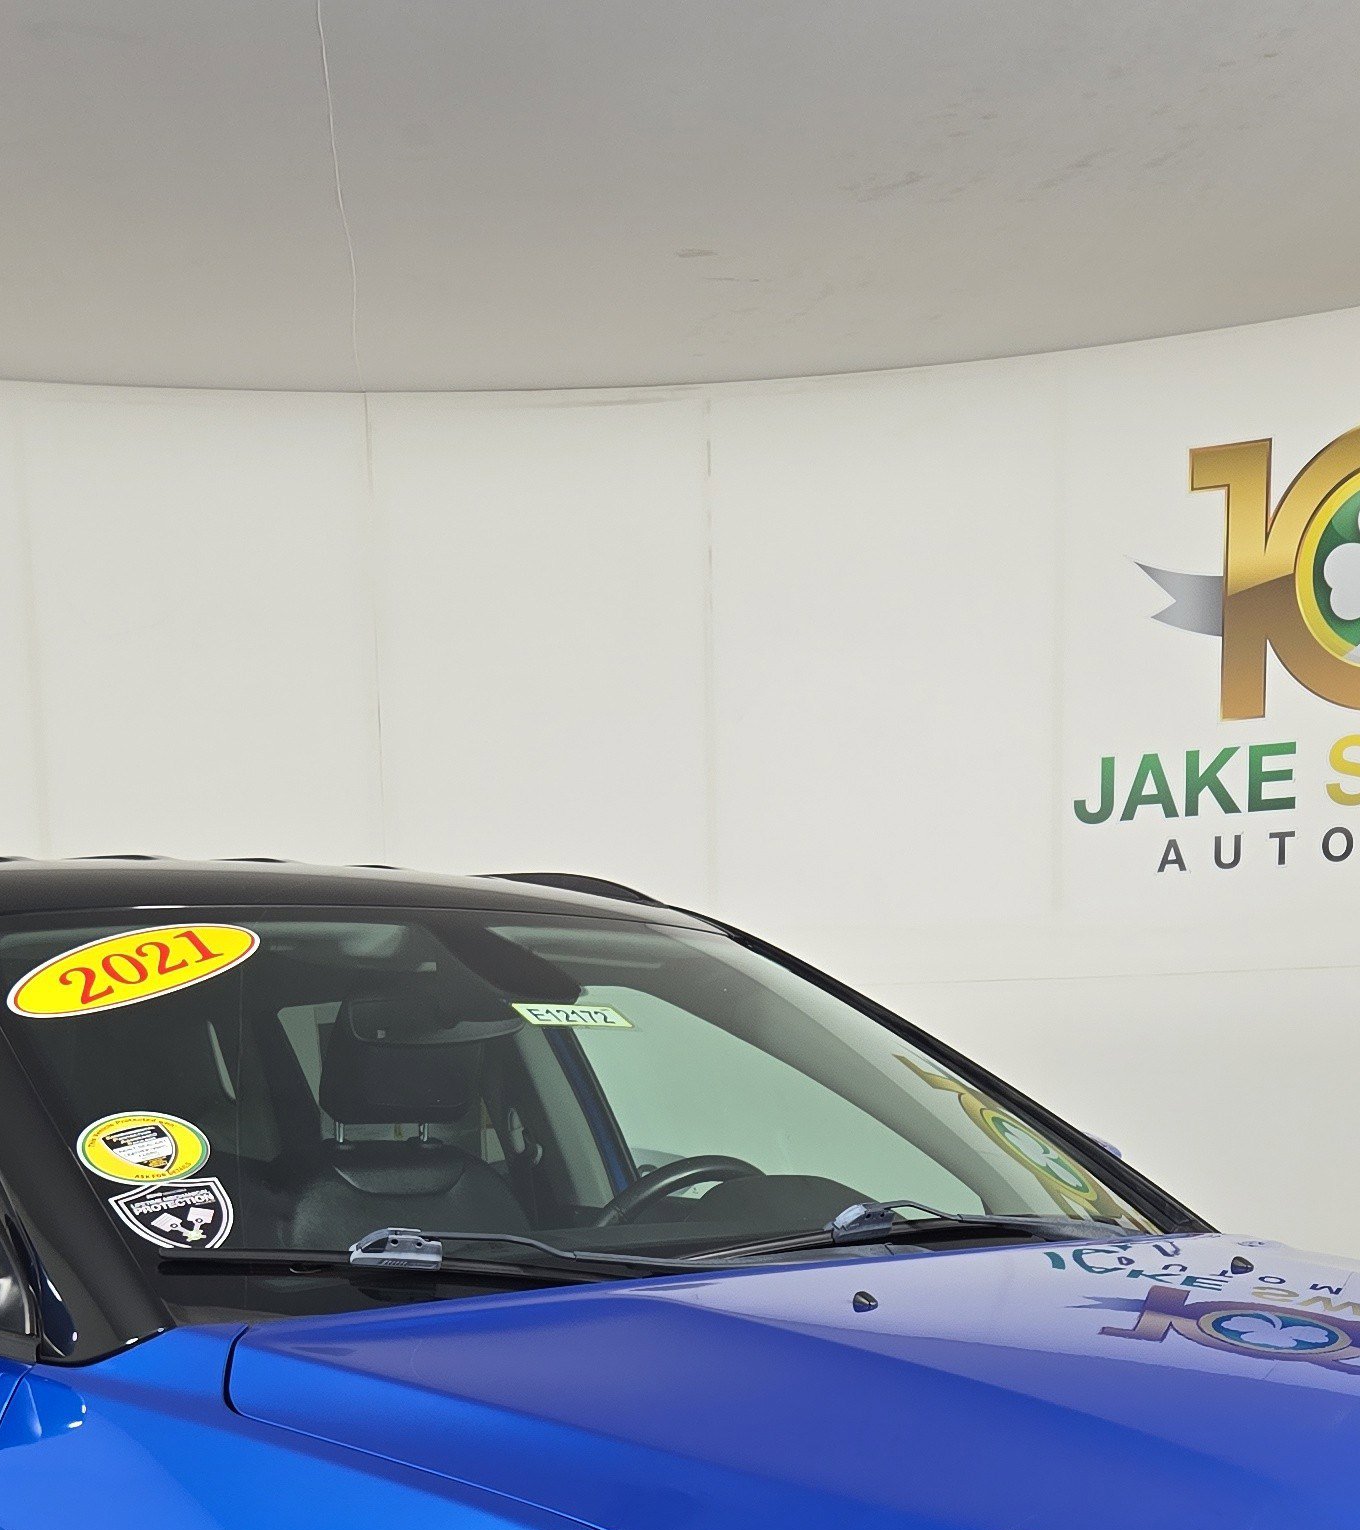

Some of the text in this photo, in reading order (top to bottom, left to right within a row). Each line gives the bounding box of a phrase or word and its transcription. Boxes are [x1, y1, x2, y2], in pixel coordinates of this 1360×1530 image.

[1073, 741, 1297, 825] JAKE
[58, 930, 226, 1004] 2021
[526, 1008, 616, 1024] E12172
[132, 1195, 215, 1216] PROTECTION
